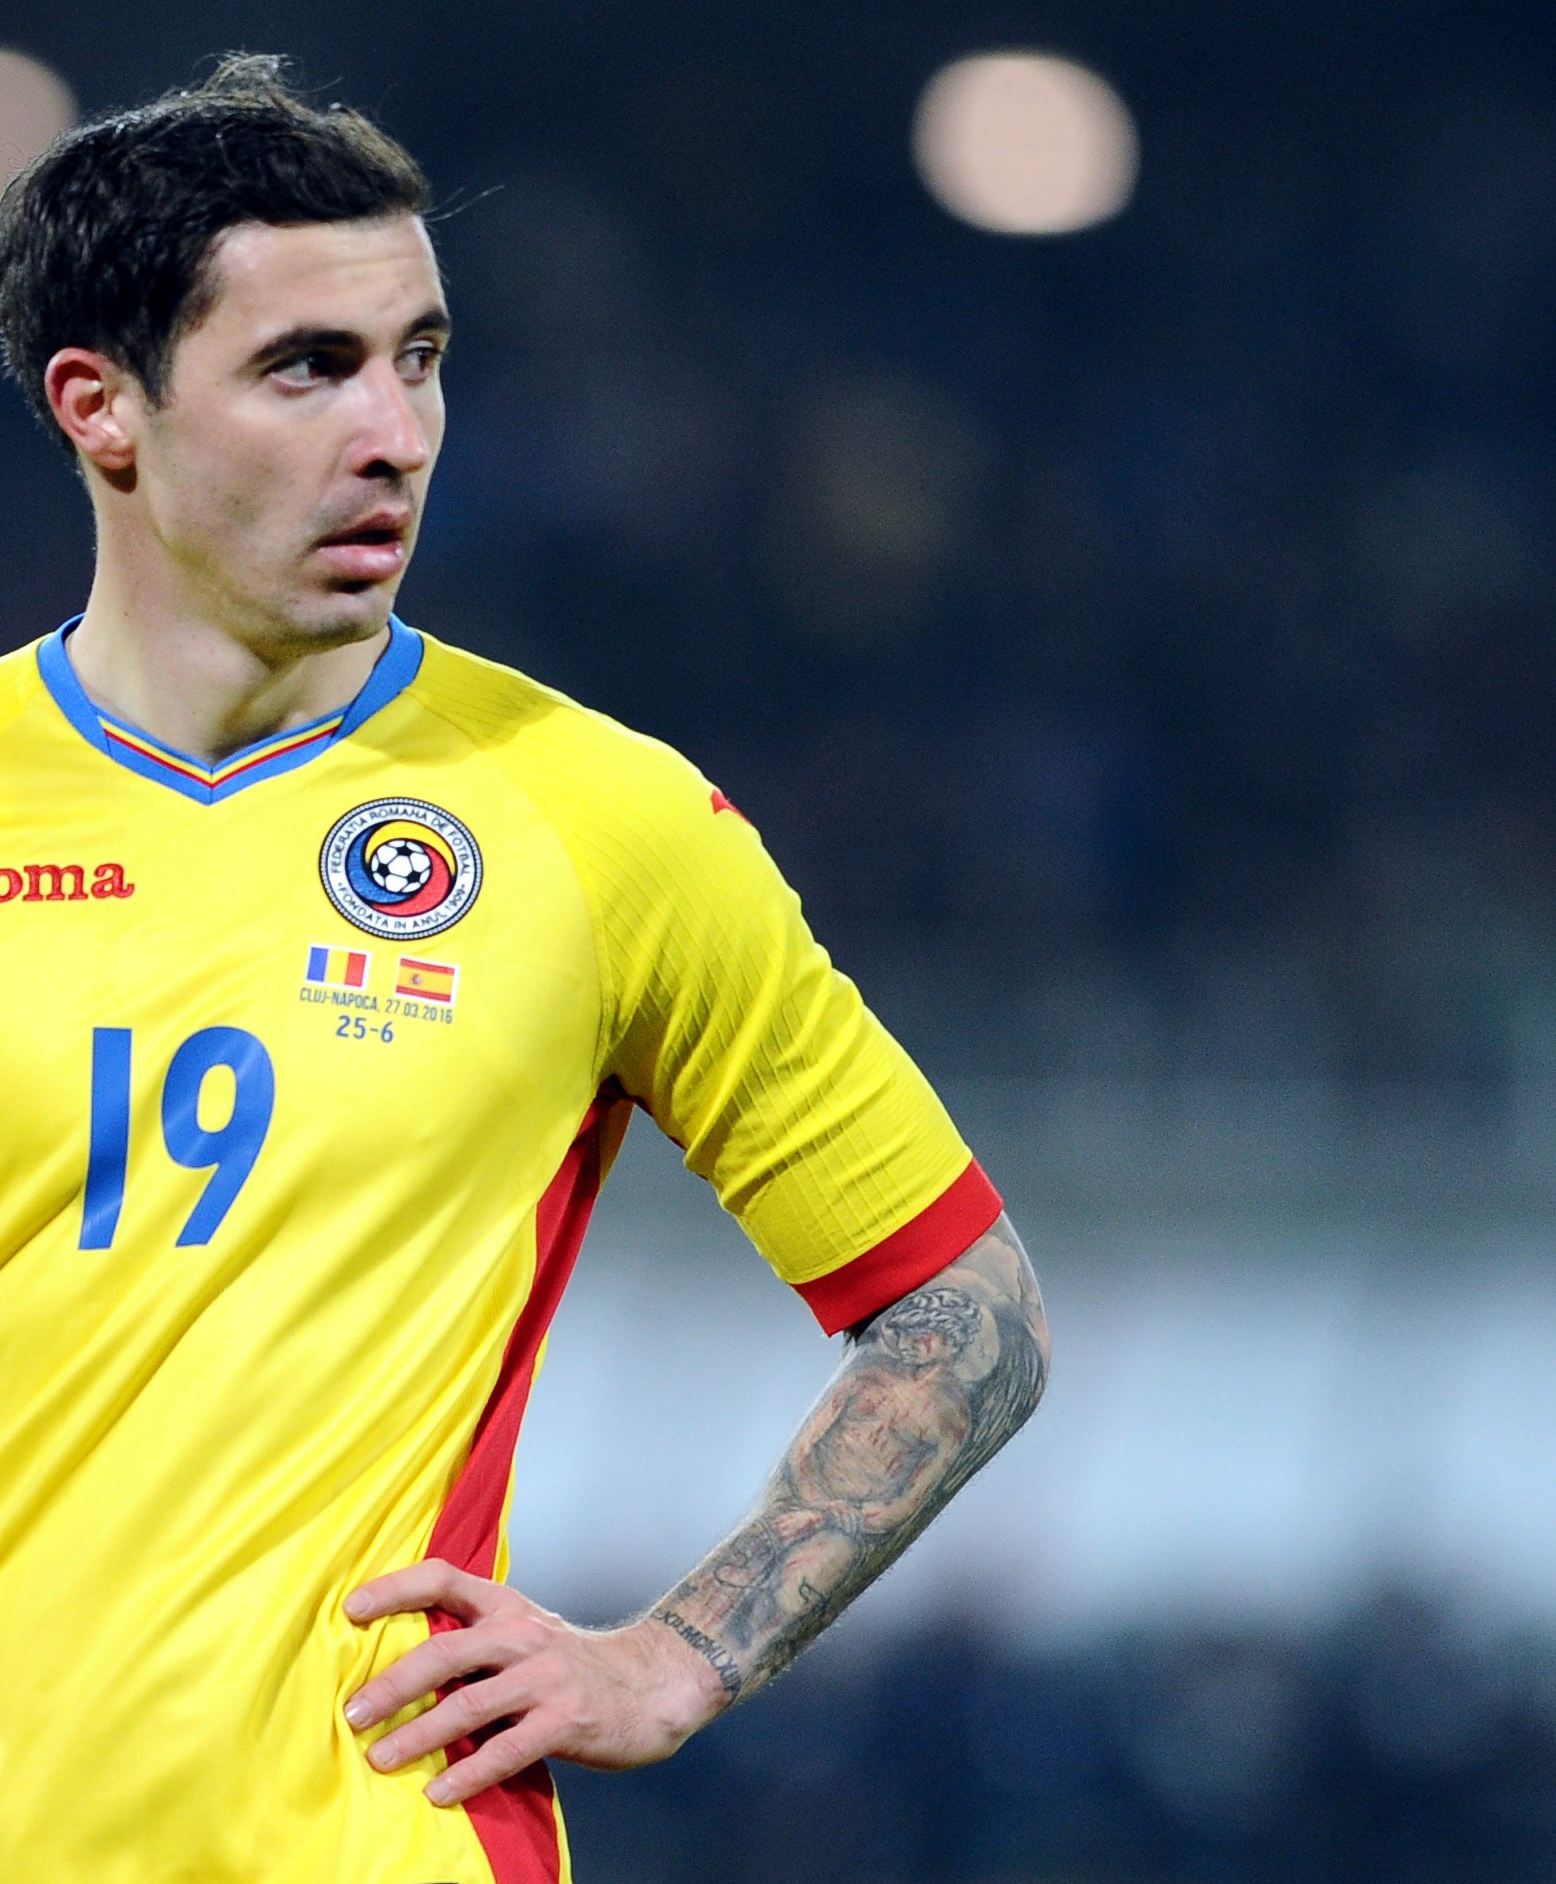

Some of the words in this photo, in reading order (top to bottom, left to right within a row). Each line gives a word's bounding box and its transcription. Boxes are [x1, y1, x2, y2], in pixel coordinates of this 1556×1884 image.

[431, 815, 450, 832] DE
[447, 829, 472, 877] FOTBAL
[394, 920, 407, 931] IN
[412, 910, 448, 929] ANUL
[384, 998, 454, 1025] 27.03.2016
[335, 1014, 395, 1044] 25-6
[77, 1025, 276, 1251] 19
